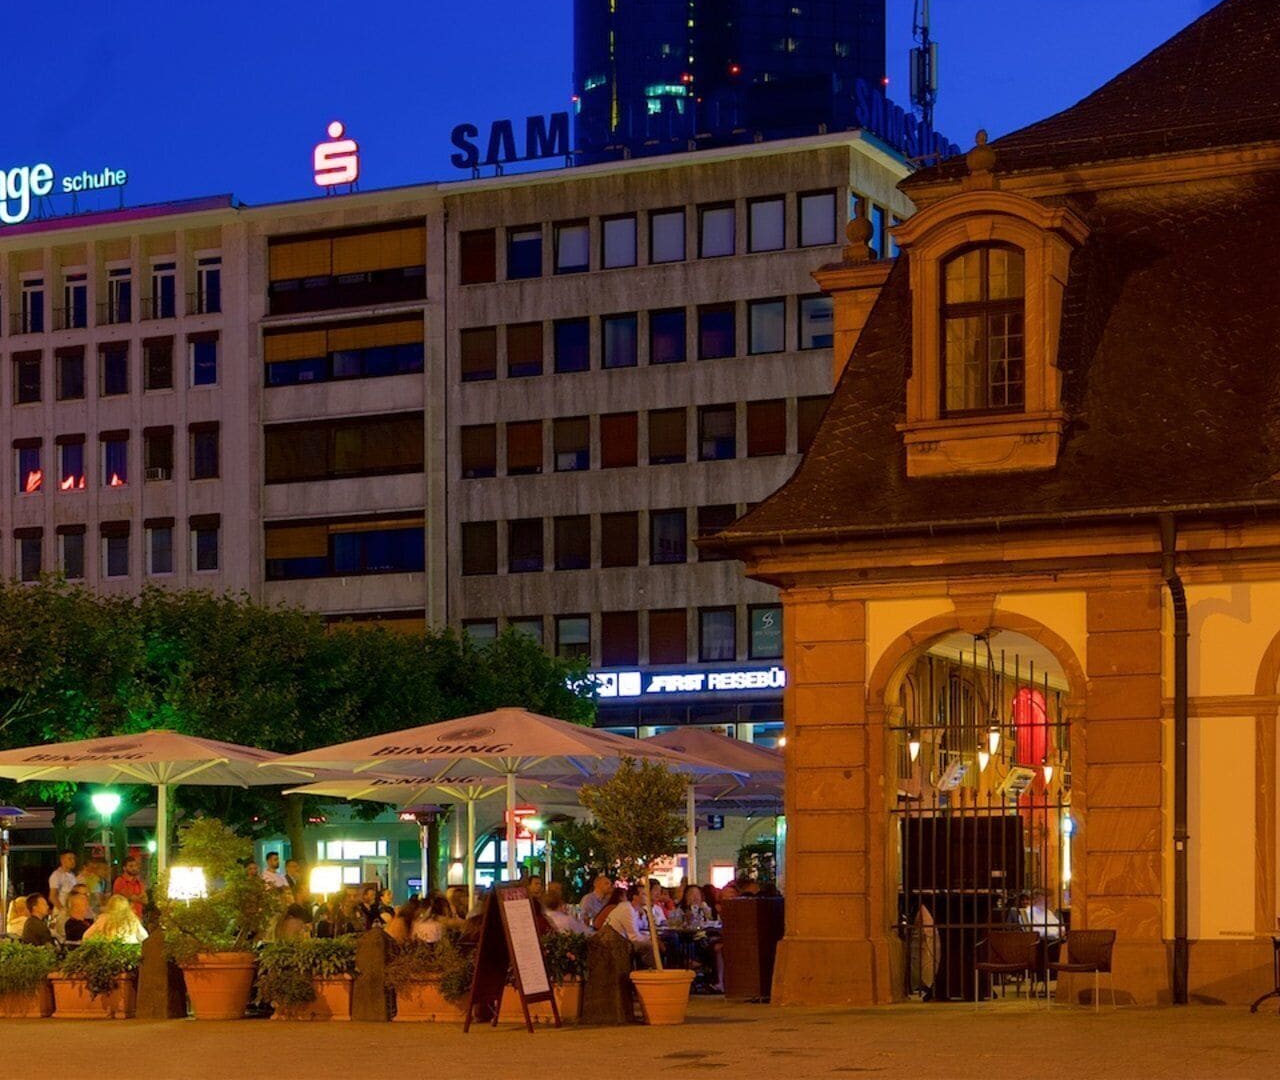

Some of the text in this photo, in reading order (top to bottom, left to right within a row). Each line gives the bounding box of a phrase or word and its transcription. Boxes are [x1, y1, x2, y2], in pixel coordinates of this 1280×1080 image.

[62, 167, 127, 193] schuhe
[708, 667, 786, 690] REISEBÜ
[371, 743, 513, 757] BINDING
